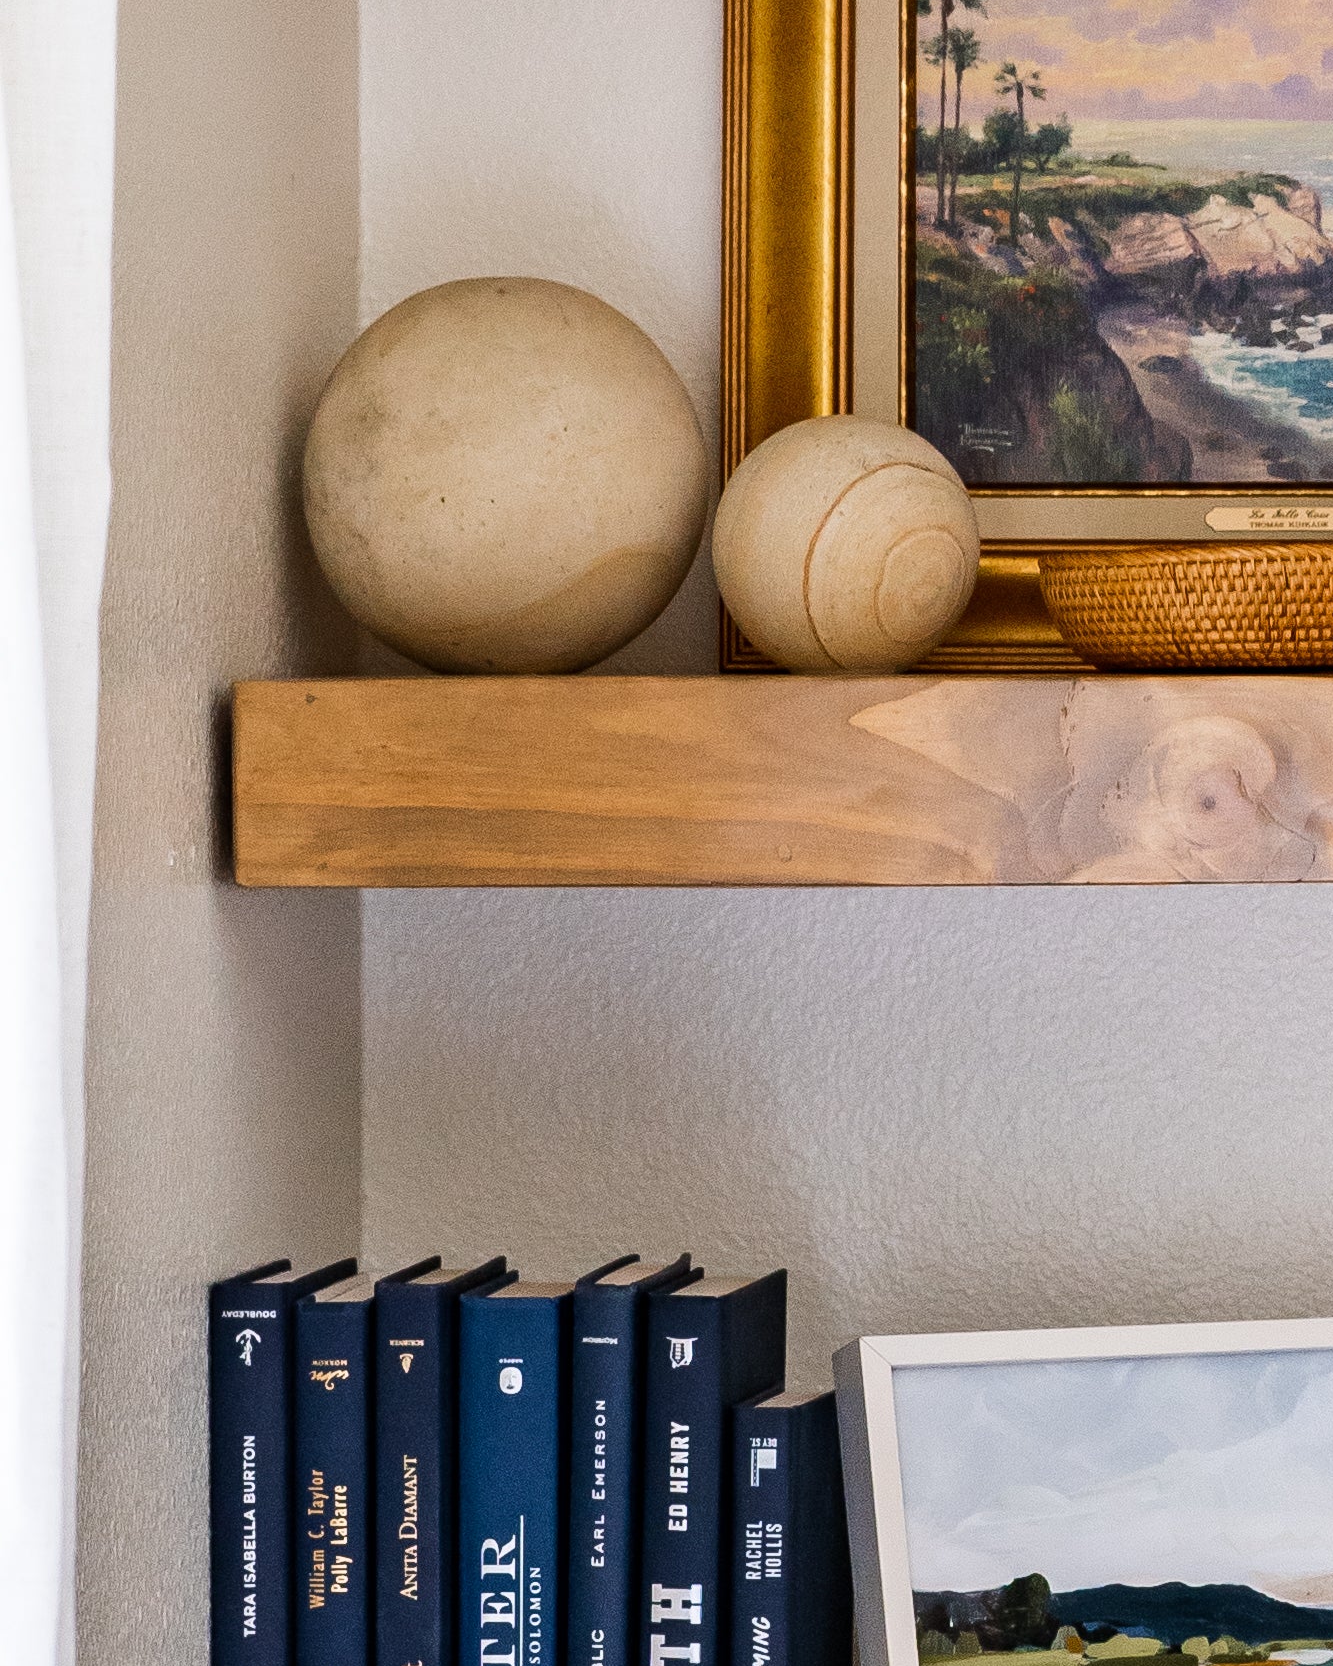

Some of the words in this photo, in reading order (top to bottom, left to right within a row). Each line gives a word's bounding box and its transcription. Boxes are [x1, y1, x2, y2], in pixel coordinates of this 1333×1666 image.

[222, 1309, 277, 1319] DOUBLEDAY
[591, 1399, 607, 1501] EMERSON
[669, 1421, 690, 1494] HENRY
[750, 1437, 761, 1447] ST.
[763, 1438, 777, 1447] DEY
[242, 1435, 256, 1504] BURTON
[307, 1469, 329, 1516] Taylor
[307, 1524, 325, 1539] C.
[329, 1485, 348, 1545] LaBarre
[590, 1514, 606, 1568] EARL
[667, 1504, 688, 1532] ED
[243, 1508, 257, 1589] ISABELLA
[330, 1555, 353, 1593] Polly
[745, 1520, 763, 1580] RACHEL
[764, 1523, 783, 1578] HOLLIS
[309, 1549, 325, 1609] William
[243, 1593, 257, 1638] TARA
[528, 1567, 542, 1665] SOLOMON
